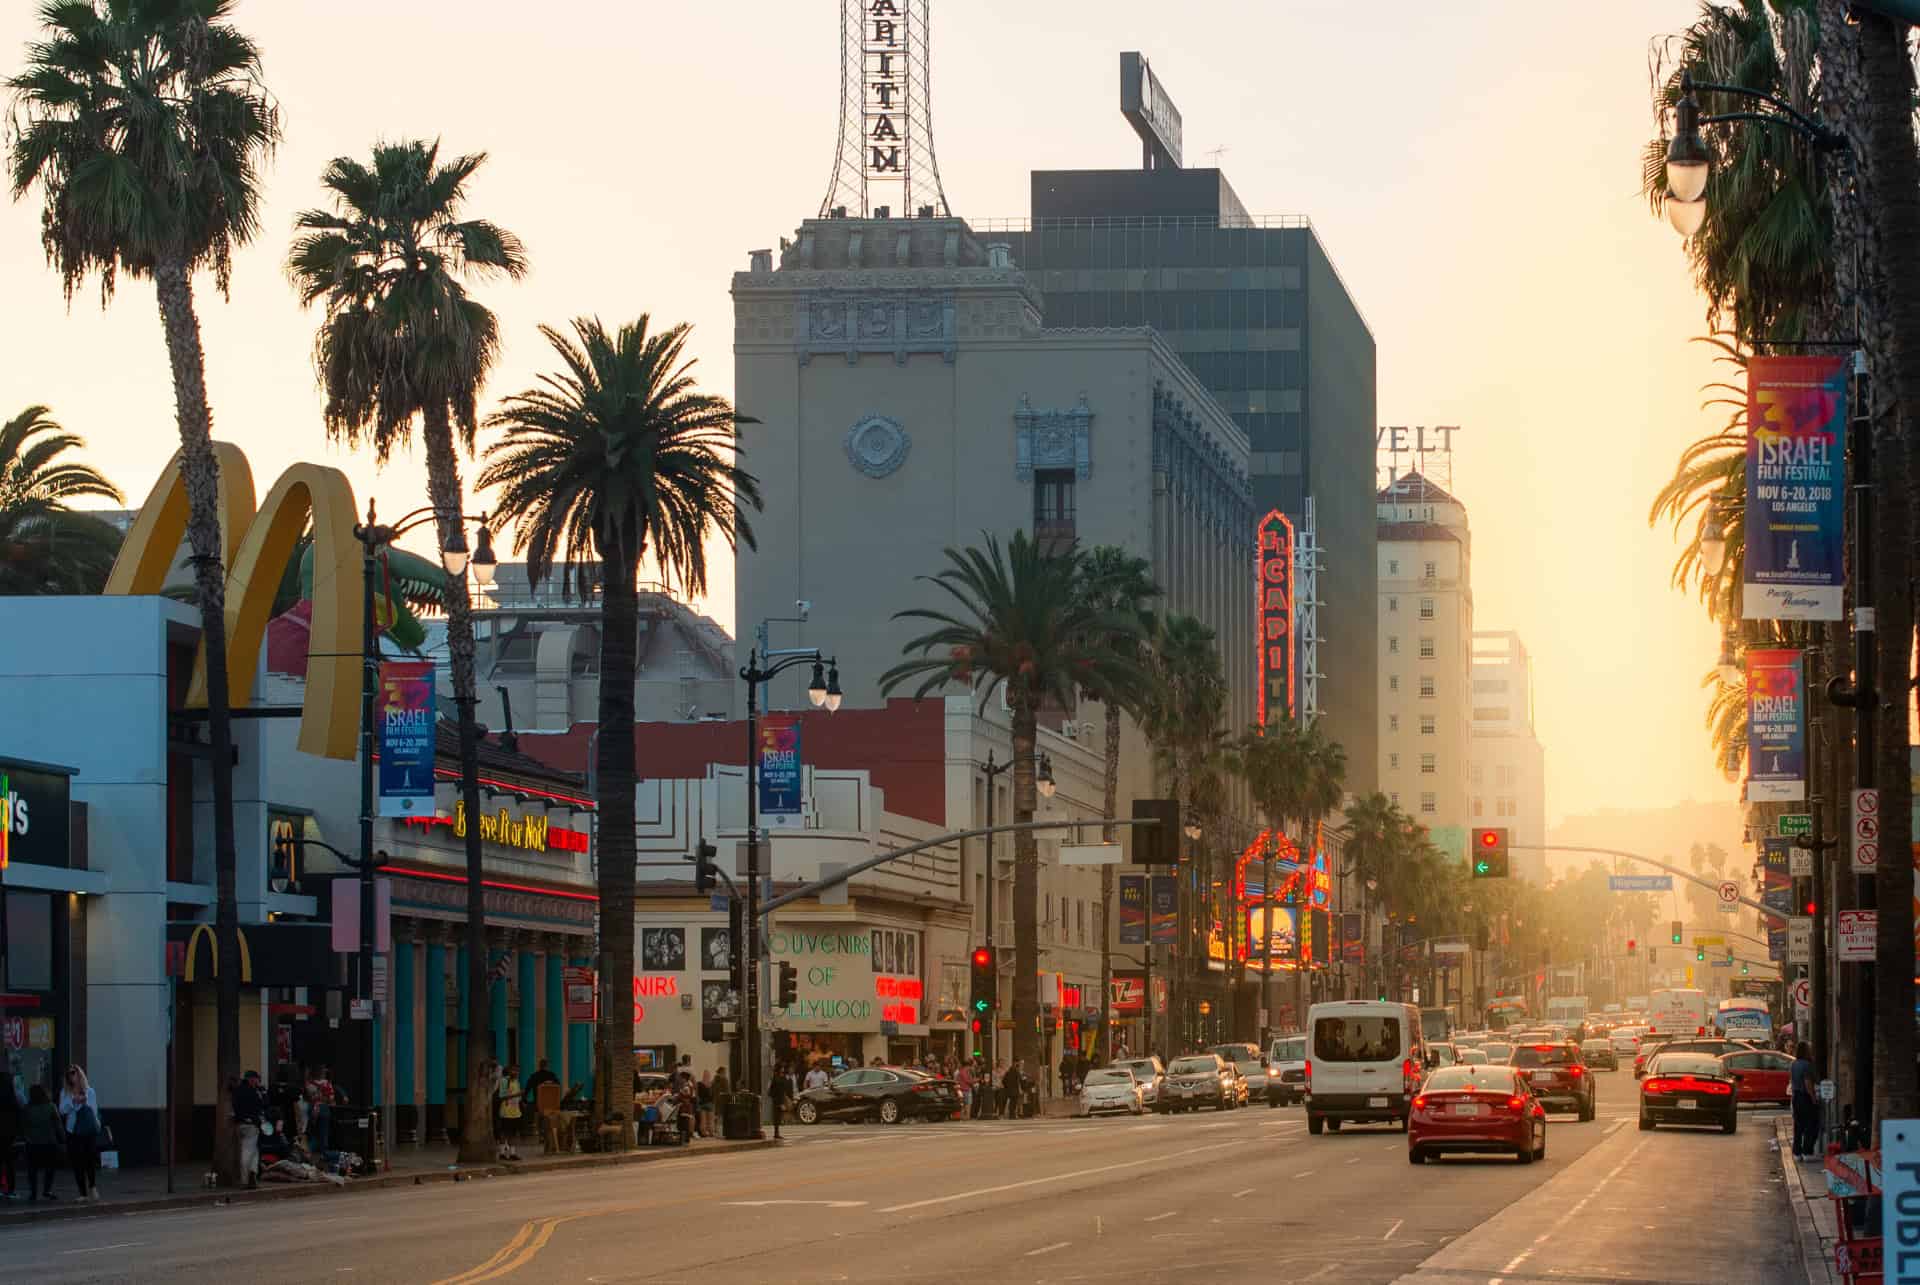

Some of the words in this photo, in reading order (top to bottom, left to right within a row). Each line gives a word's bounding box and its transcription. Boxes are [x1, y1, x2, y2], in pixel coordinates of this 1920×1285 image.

[1757, 435, 1832, 465] ISRAEL
[1758, 465, 1781, 479] FILM
[1785, 465, 1831, 480] FESTIVAL
[1757, 486, 1779, 499] NOV
[1809, 487, 1832, 500] 2018
[1772, 502, 1785, 511] LOS
[1787, 502, 1817, 512] ANGELES
[1263, 559, 1288, 722] CAPITA
[1753, 695, 1796, 712] ISRAEL
[386, 709, 428, 726] ISRAEL
[764, 751, 795, 761] ISRAEL
[512, 821, 523, 847] or
[768, 933, 870, 956] OUVENIRS
[808, 967, 838, 986] OF
